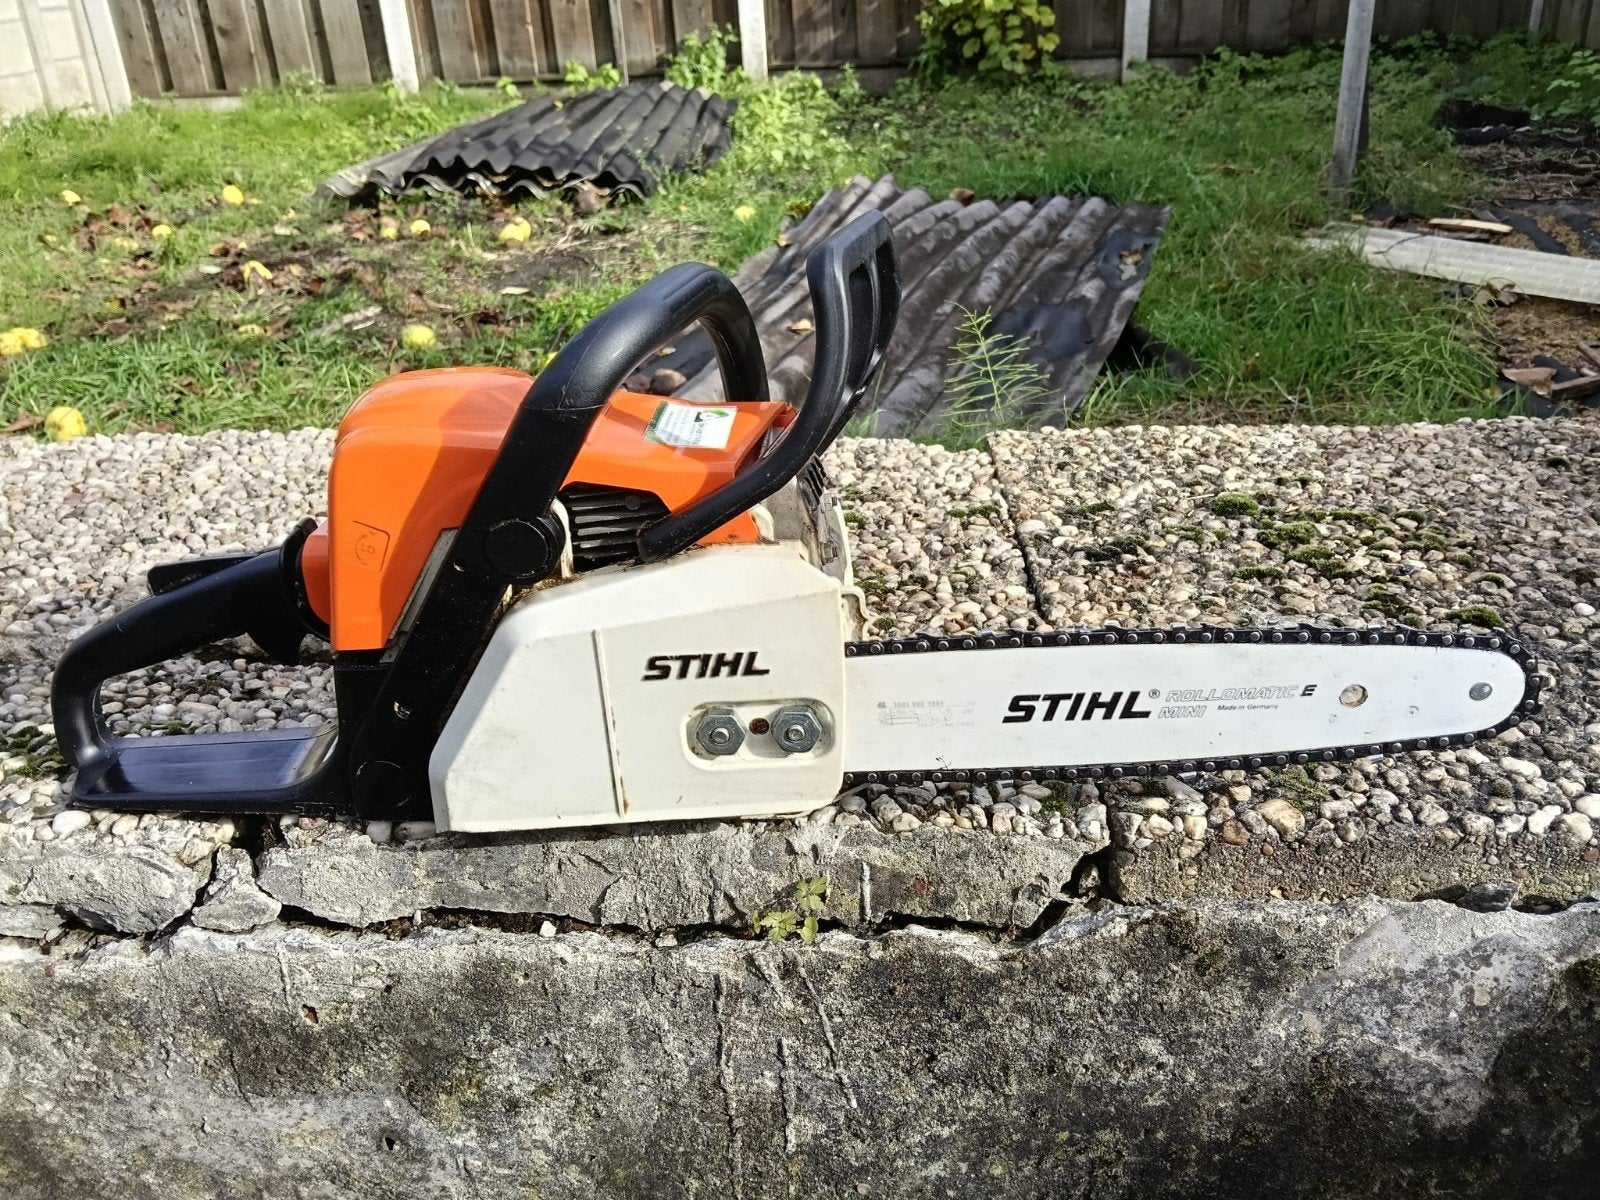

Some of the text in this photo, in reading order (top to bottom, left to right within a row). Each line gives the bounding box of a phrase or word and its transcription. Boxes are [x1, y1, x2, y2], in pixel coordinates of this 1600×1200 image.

[641, 651, 770, 681] STIHL
[1165, 684, 1298, 702] ROLLOMATIC
[1300, 684, 1318, 697] E
[1157, 705, 1207, 719] MINI
